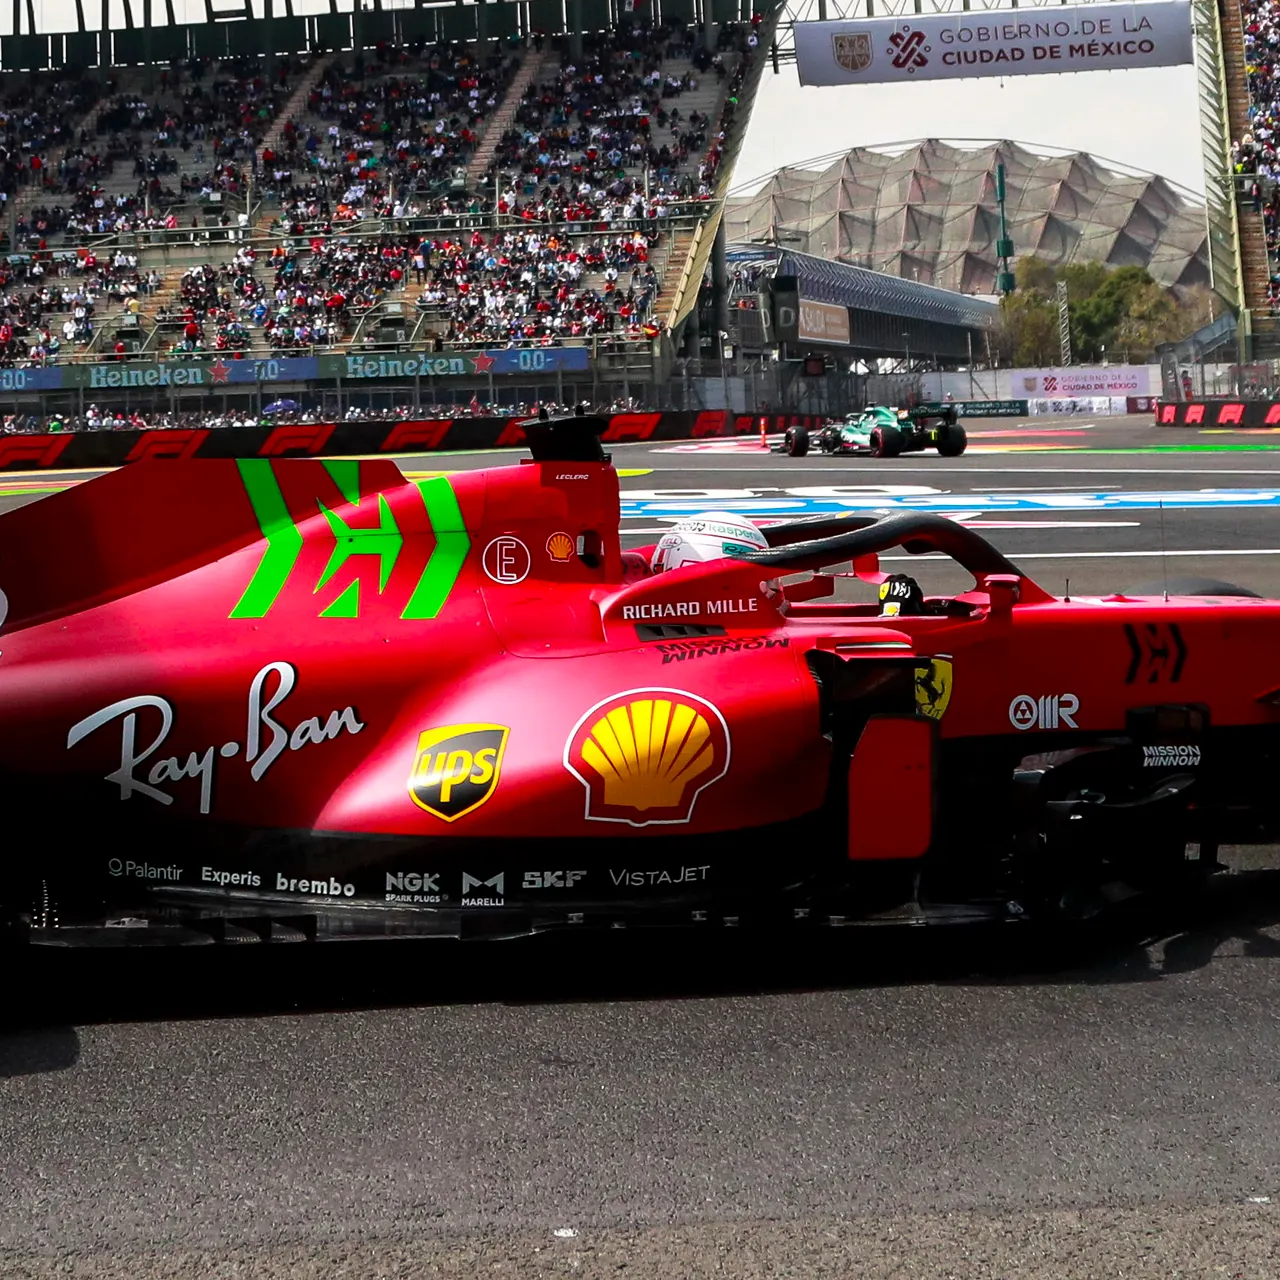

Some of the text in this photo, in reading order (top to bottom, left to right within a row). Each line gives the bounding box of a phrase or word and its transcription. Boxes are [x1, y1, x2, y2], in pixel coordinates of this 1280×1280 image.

[940, 16, 1153, 44] GOBIERNO DE LA
[941, 37, 1155, 66] CIUDAD DE MÉXICO
[90, 364, 203, 388] Heineken
[346, 354, 466, 378] Heineken
[1061, 374, 1109, 383] GOBIERNO
[1111, 374, 1125, 382] DE
[1107, 381, 1138, 390] MÉXICO
[555, 473, 590, 481] LECLERC
[497, 540, 517, 580] E
[623, 597, 759, 620] RICHARD MILLE
[662, 637, 790, 664] WINNOW
[1142, 744, 1201, 757] MISSION
[1142, 756, 1201, 768] WINNOW
[420, 747, 497, 803] ups
[125, 859, 184, 881] Palantir
[201, 865, 262, 887] Experis
[522, 869, 588, 889] SKF
[276, 872, 357, 898] brembo
[386, 870, 441, 893] NGK
[385, 892, 441, 903] SPARK PLUGS
[461, 897, 505, 907] MARELLI
